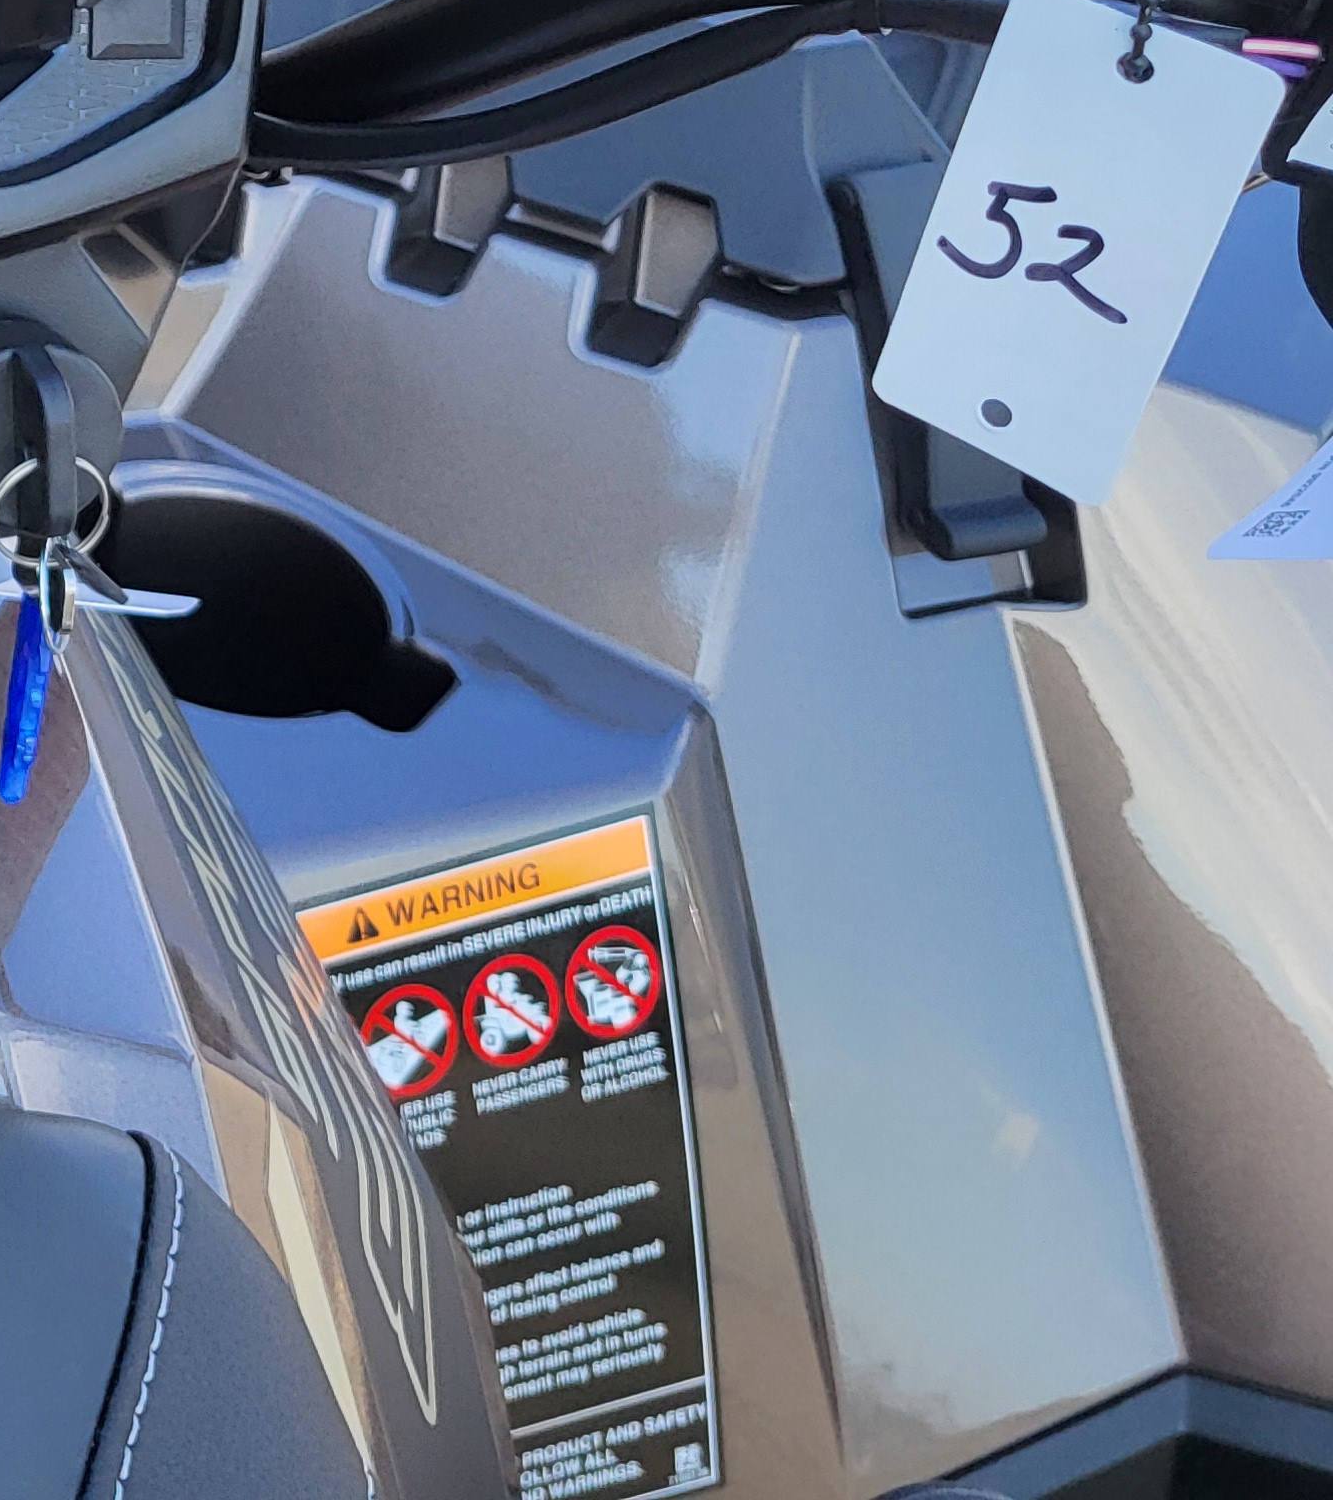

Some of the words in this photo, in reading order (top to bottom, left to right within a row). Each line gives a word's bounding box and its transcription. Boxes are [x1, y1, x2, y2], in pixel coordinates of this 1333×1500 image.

[936, 181, 1128, 324] 52
[386, 862, 541, 927] WARNING
[346, 967, 374, 991] use
[374, 959, 403, 982] can
[403, 944, 447, 973] result
[462, 920, 527, 957] SEVERE
[527, 904, 583, 938] INJURY
[583, 902, 599, 922] or
[599, 885, 653, 917] DEATH
[471, 1071, 520, 1100] NEVER
[519, 1057, 570, 1085] CARRY
[582, 1037, 627, 1066] NEVER
[628, 1031, 663, 1053] USE
[475, 1074, 571, 1116] PASSENGERS
[522, 1430, 604, 1470] PRODUCT
[606, 1420, 644, 1447] AND
[643, 1401, 706, 1437] SAFETY
